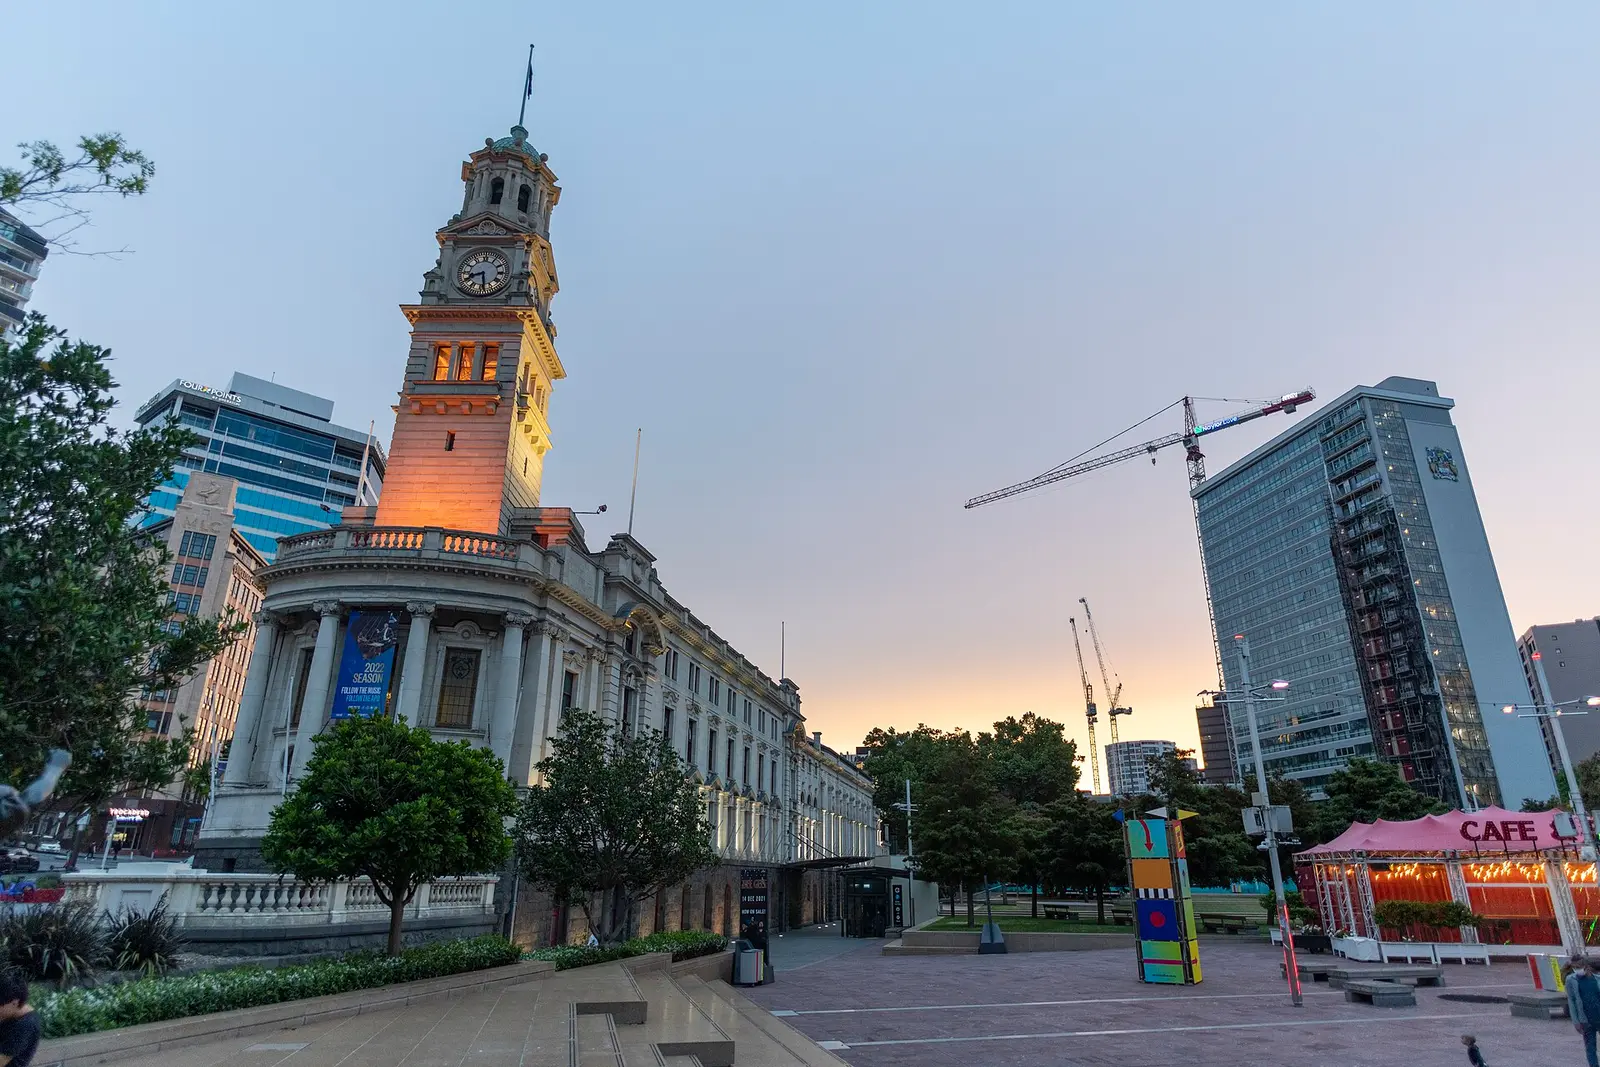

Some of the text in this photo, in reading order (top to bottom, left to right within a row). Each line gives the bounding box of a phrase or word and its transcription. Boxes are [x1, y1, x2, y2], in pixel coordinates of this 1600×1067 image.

[180, 380, 241, 402] FOUR POINTS
[183, 515, 223, 533] MLC
[364, 662, 384, 672] 2022
[352, 673, 383, 683] SEASON
[1459, 820, 1538, 841] CAFE
